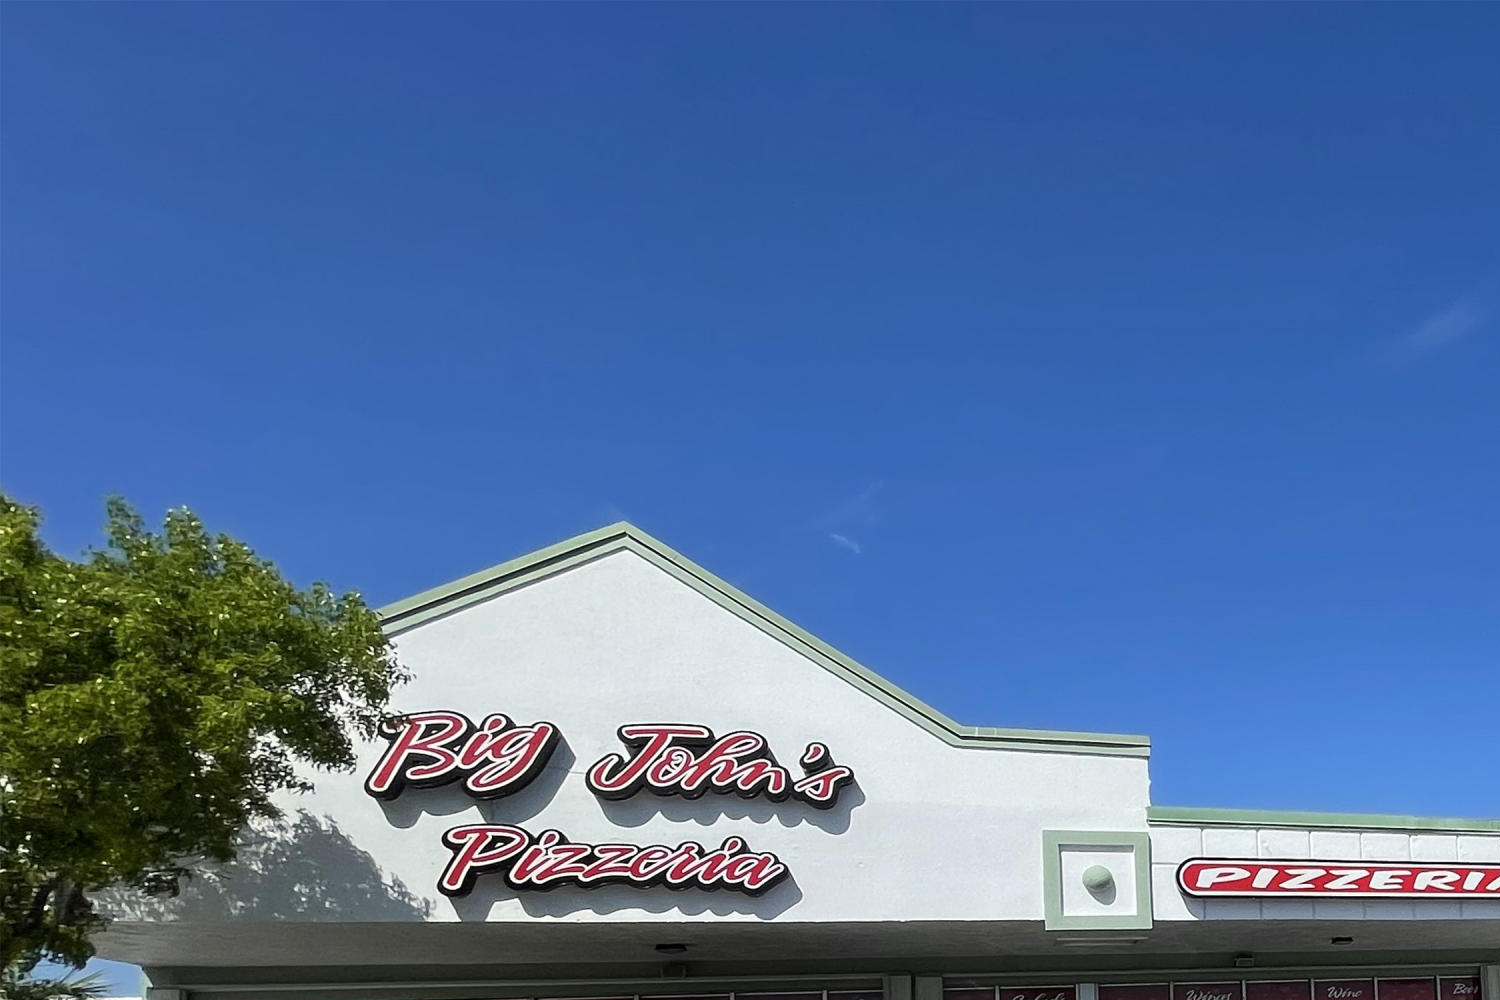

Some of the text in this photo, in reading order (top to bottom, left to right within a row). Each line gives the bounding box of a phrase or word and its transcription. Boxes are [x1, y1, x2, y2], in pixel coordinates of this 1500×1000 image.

[365, 710, 856, 810] Big John's
[437, 824, 791, 898] Pizzeria
[1327, 986, 1362, 999] Wine
